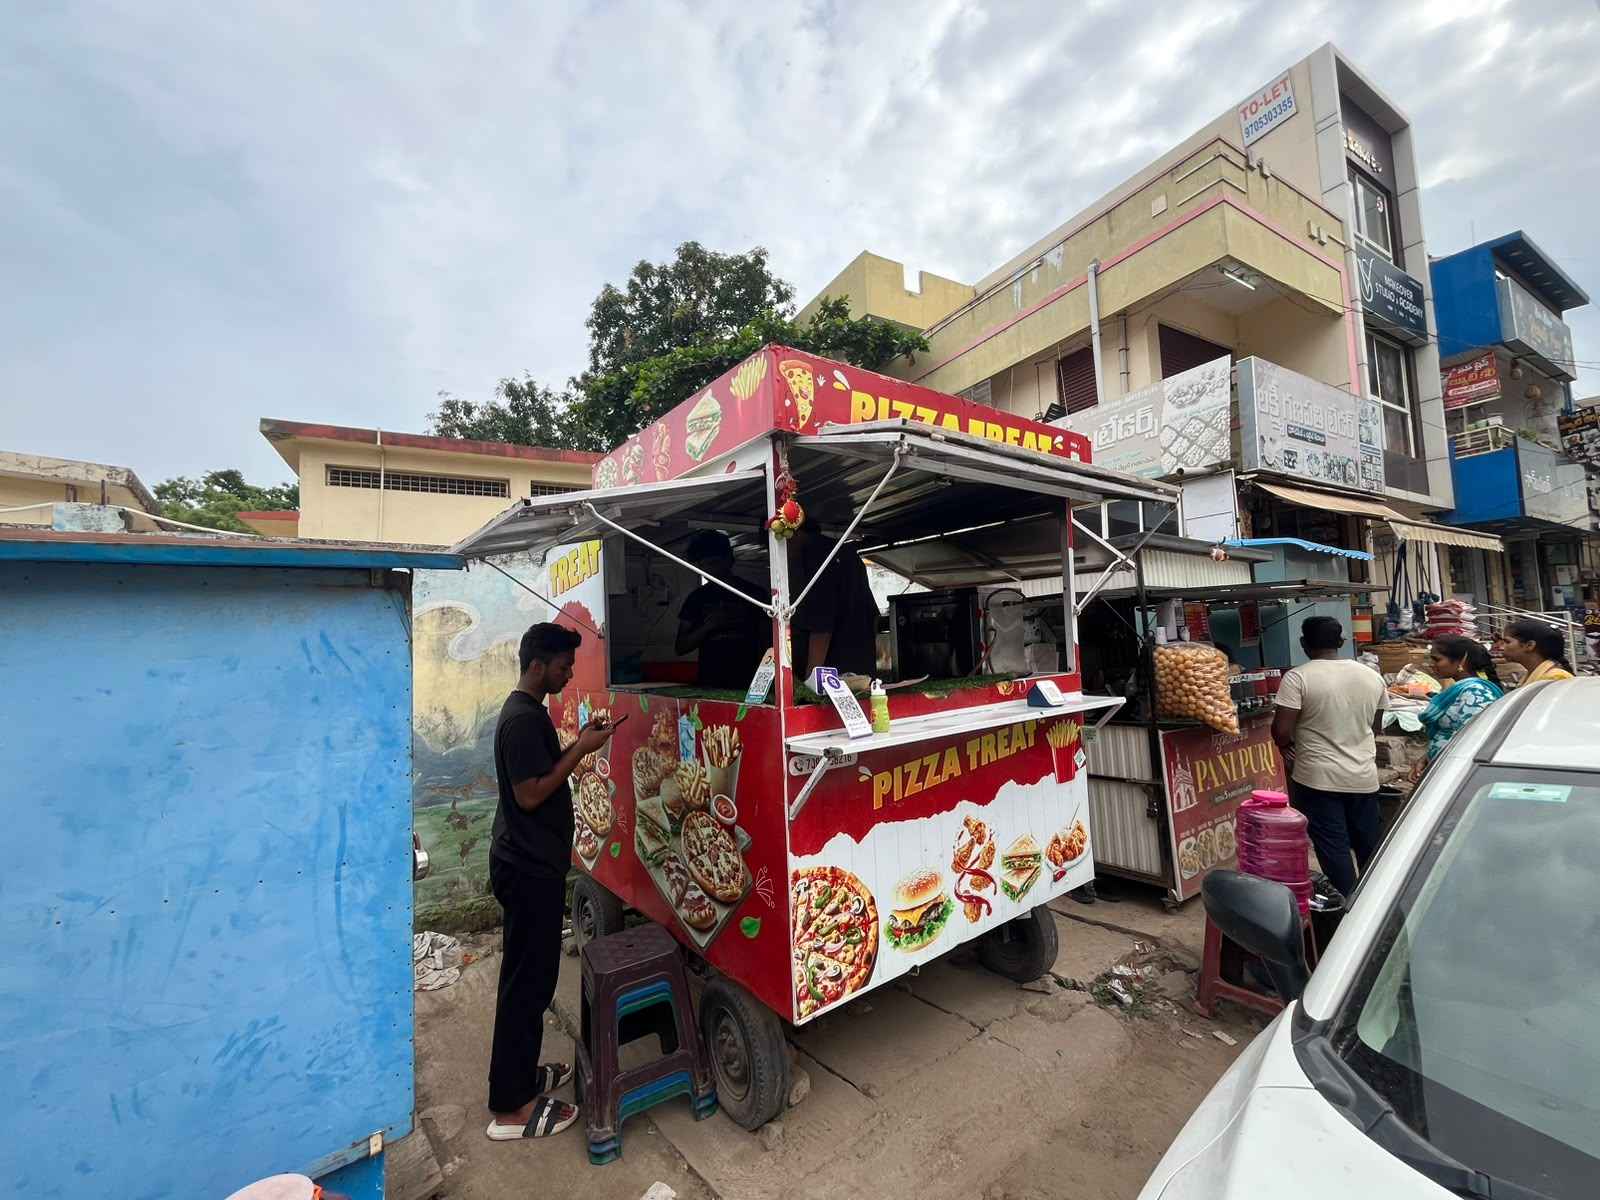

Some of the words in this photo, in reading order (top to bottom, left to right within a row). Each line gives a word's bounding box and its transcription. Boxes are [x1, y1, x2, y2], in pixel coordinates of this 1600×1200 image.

[1240, 77, 1289, 121] TO-LET
[1244, 96, 1293, 138] 9705303355
[1375, 282, 1396, 302] STUDIO
[1399, 297, 1424, 319] ACADEMY
[1384, 275, 1413, 301] MAKEOVER
[550, 539, 601, 598] TREAT
[873, 746, 961, 810] PIZZA
[966, 719, 1038, 771] TREAT
[1194, 750, 1238, 793] PANI
[1238, 739, 1277, 782] PURI
